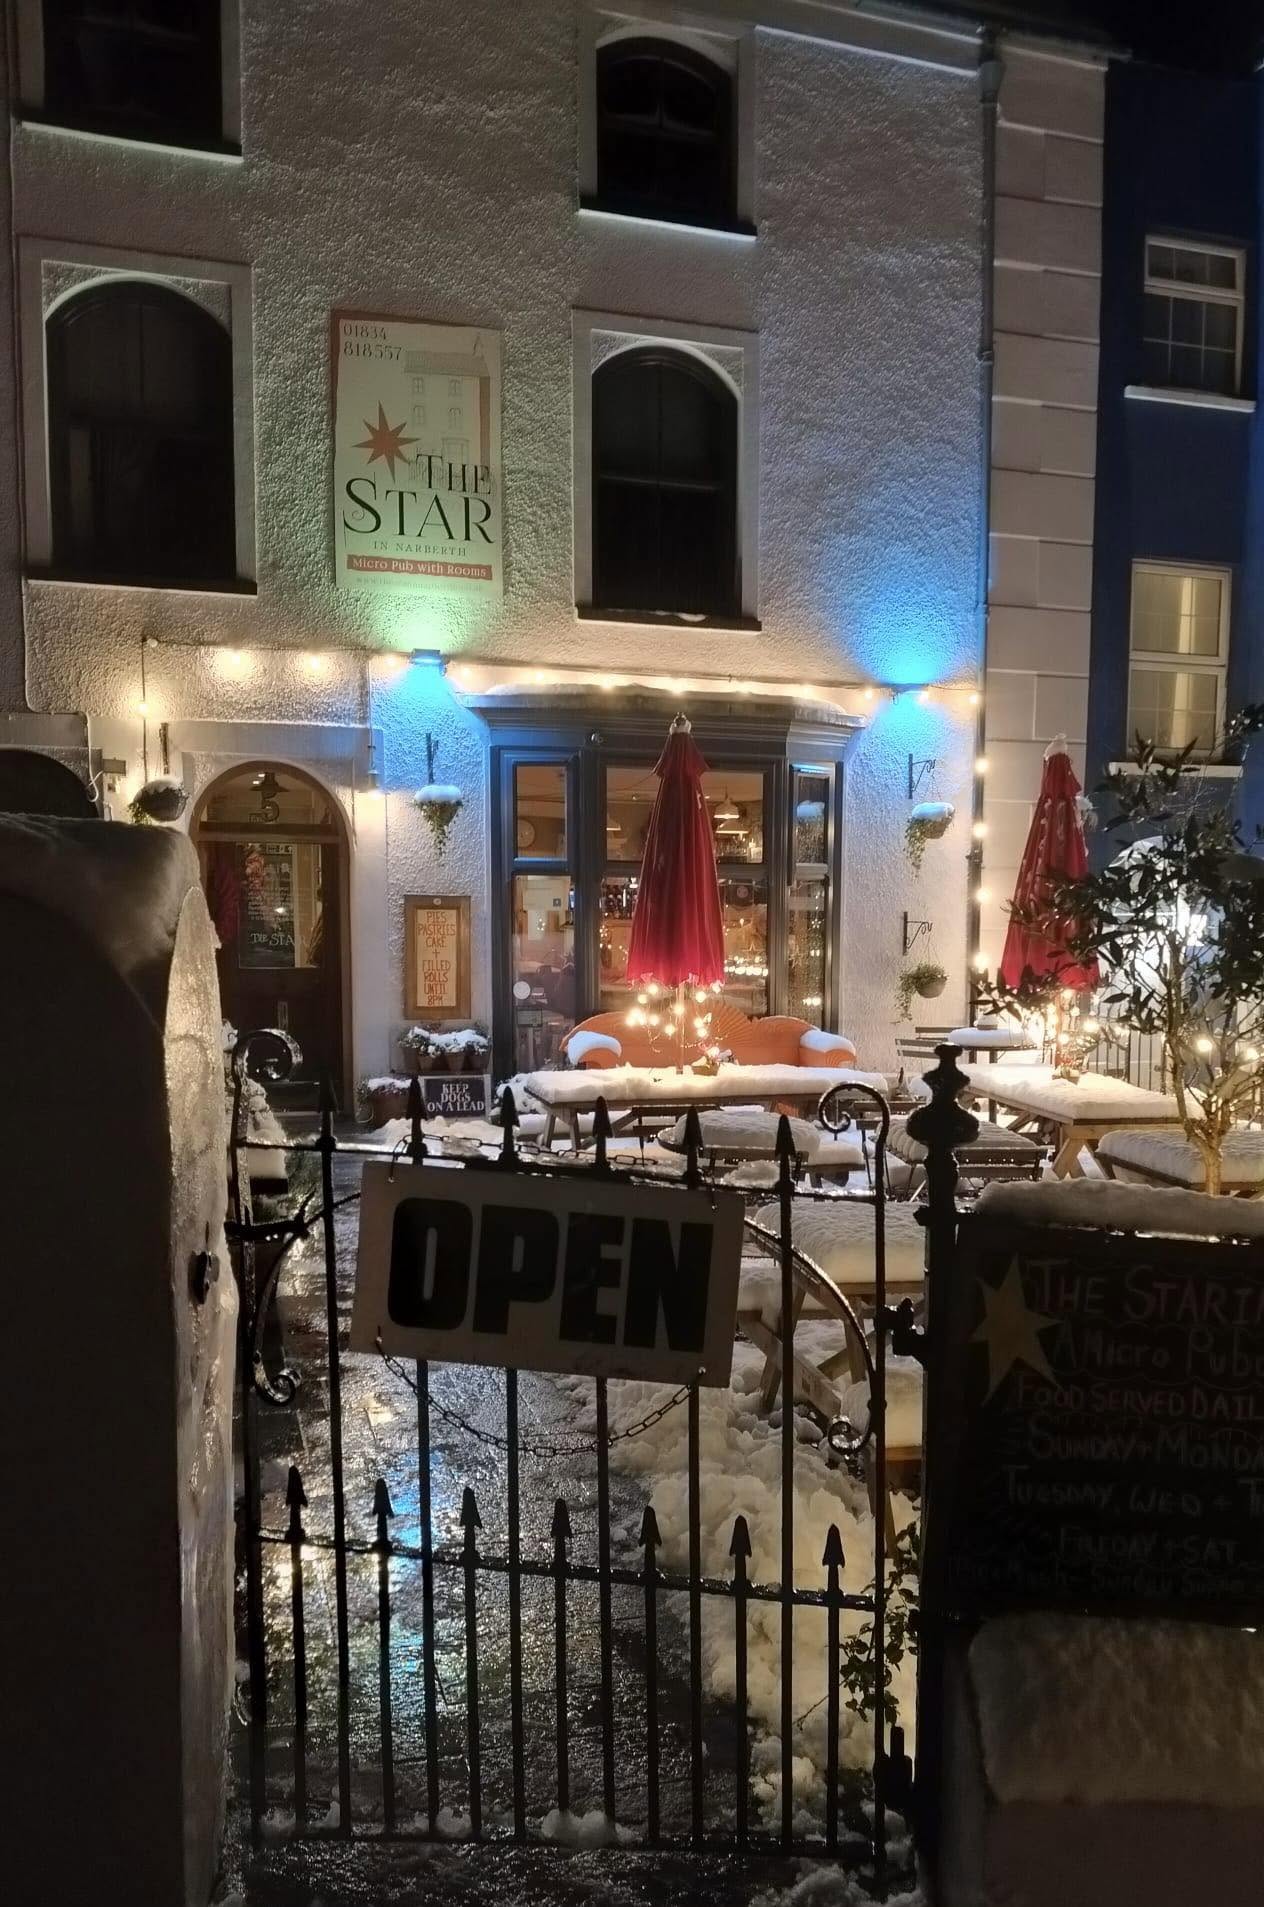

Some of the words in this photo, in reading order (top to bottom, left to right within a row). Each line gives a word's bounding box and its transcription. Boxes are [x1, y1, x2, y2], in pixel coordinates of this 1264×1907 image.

[342, 324, 388, 340] 01834
[343, 341, 402, 361] 818557
[343, 475, 494, 545] STAR
[373, 540, 388, 550] IN
[394, 543, 467, 557] NARBERTH
[352, 557, 388, 569] Micro
[392, 560, 414, 573] Pub
[417, 563, 443, 575] with
[447, 566, 487, 578] Rooms
[426, 911, 447, 923] PIES
[417, 923, 456, 936] PASTRIES
[426, 936, 447, 948] CAKE
[423, 960, 451, 972] FILLED
[424, 972, 448, 982] ROLLS
[424, 984, 447, 995] UNTIL
[442, 1083, 469, 1094] KEEP
[440, 1092, 471, 1103] DOGS
[427, 1102, 443, 1112] ON
[446, 1102, 454, 1112] A
[456, 1101, 485, 1112] LEAD
[388, 1197, 714, 1353] OPEN
[1025, 1258, 1108, 1315] THE
